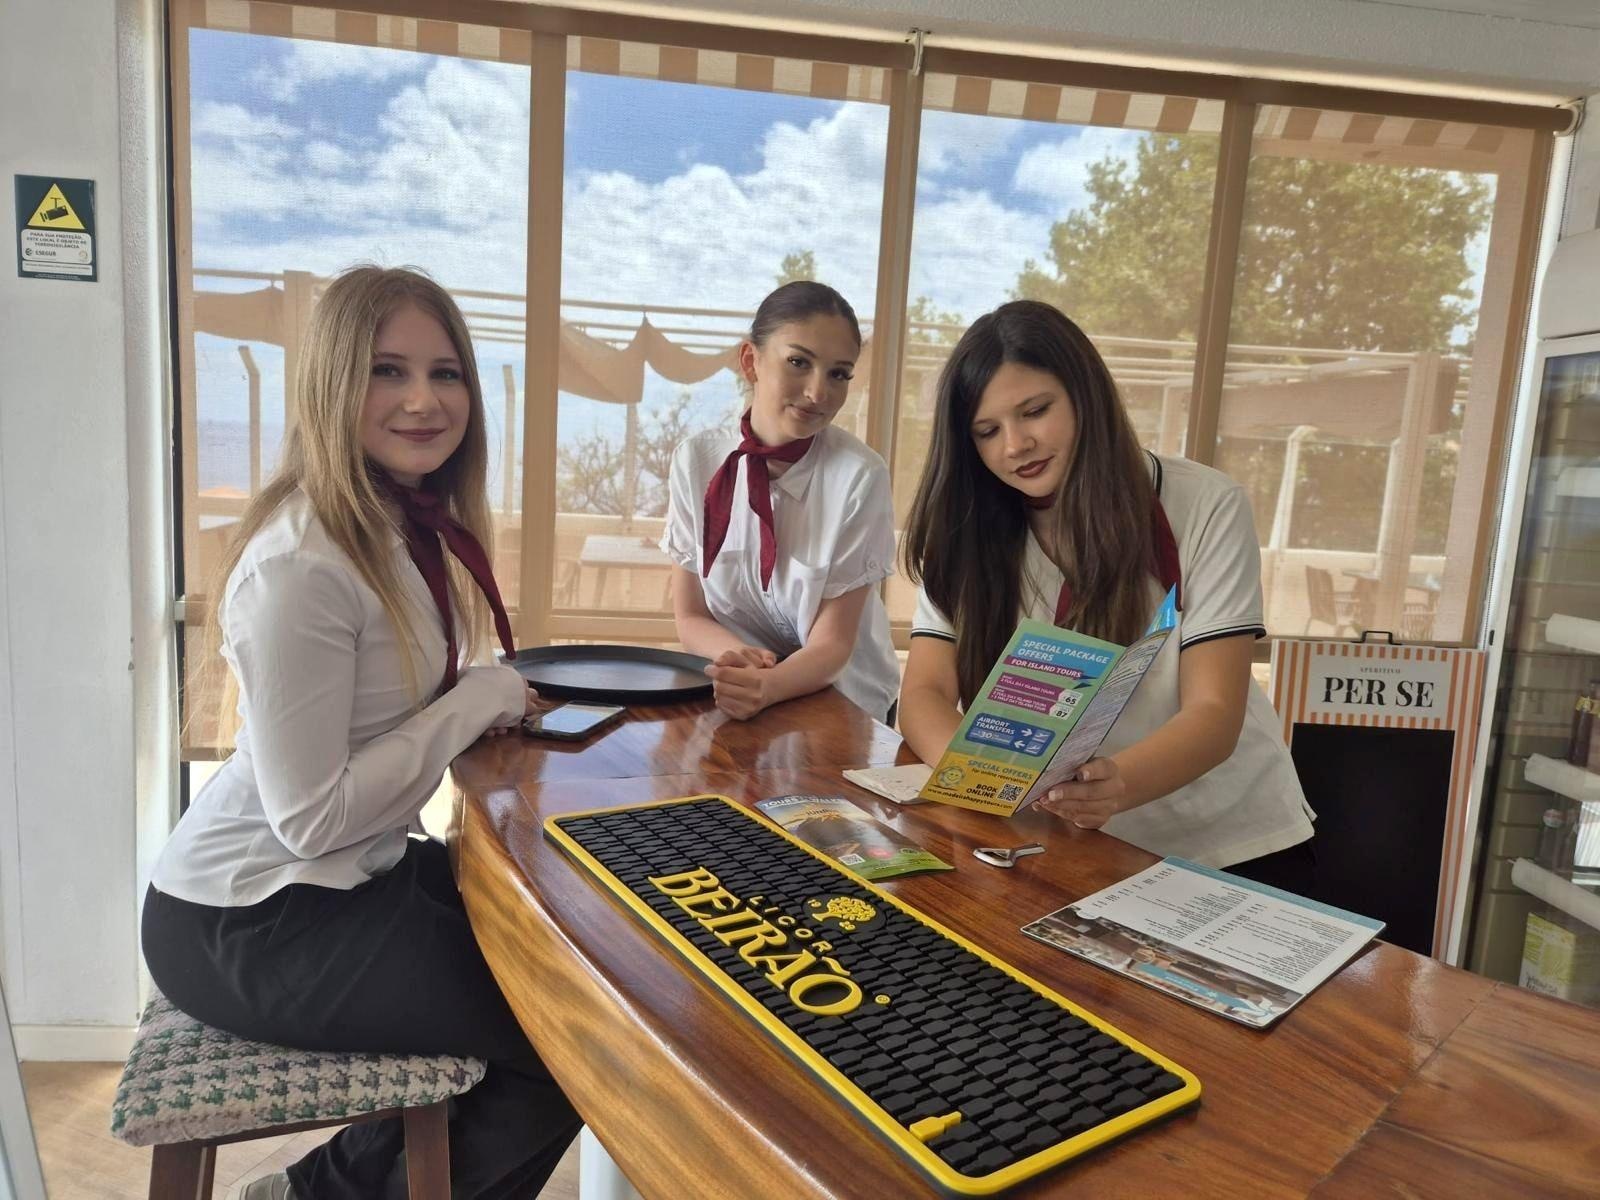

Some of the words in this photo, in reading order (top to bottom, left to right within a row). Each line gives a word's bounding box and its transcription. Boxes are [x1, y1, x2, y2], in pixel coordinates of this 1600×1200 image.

[1018, 648, 1054, 662] OFFERS
[1022, 640, 1062, 654] SPECIAL
[1062, 648, 1110, 664] PACKAGE
[1011, 658, 1028, 667] FOR
[1028, 661, 1056, 672] ISLAND
[1056, 667, 1082, 678] TOURS
[1322, 676, 1386, 706] PER
[1395, 680, 1434, 708] SE
[976, 722, 1016, 734] TRANSFERS
[978, 716, 1010, 728] AIRPORT
[968, 760, 1000, 772] SPECIAL
[1002, 768, 1033, 780] OFFERS
[928, 788, 1013, 809] www.madeirahappytours.com
[966, 788, 995, 798] ONLINE
[976, 784, 998, 793] BOOK
[749, 895, 833, 953] LICOR
[647, 866, 864, 1016] BEIRÃO
